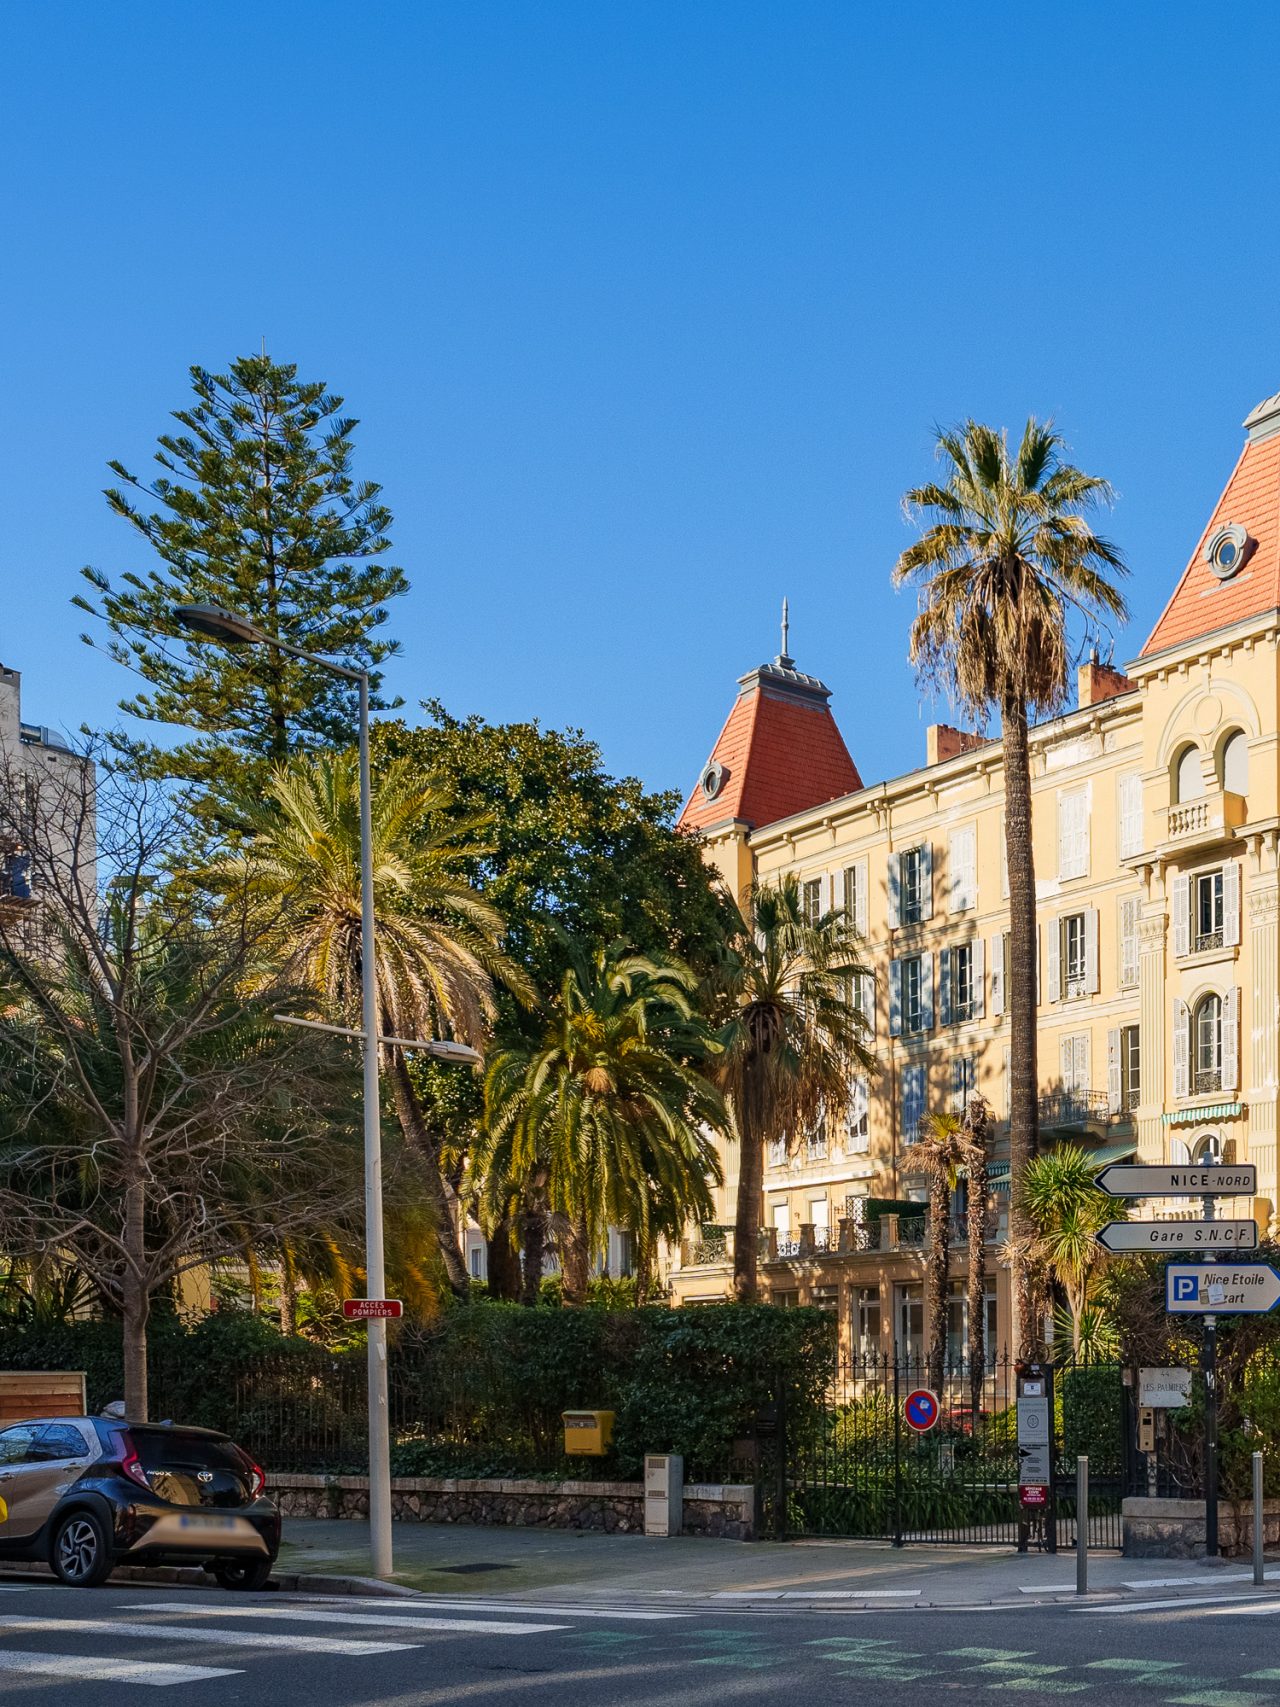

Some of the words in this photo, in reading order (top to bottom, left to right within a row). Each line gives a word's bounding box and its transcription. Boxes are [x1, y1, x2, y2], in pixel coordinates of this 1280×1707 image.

[1149, 1230, 1184, 1243] Gare
[1194, 1228, 1250, 1242] S.N.C.F.
[1203, 1273, 1230, 1285] Nice
[1231, 1273, 1265, 1285] Etoile
[1178, 1278, 1194, 1299] P
[352, 1308, 393, 1316] POMPIERS
[1143, 1383, 1154, 1392] LES
[1157, 1383, 1188, 1392] PALMIERS
